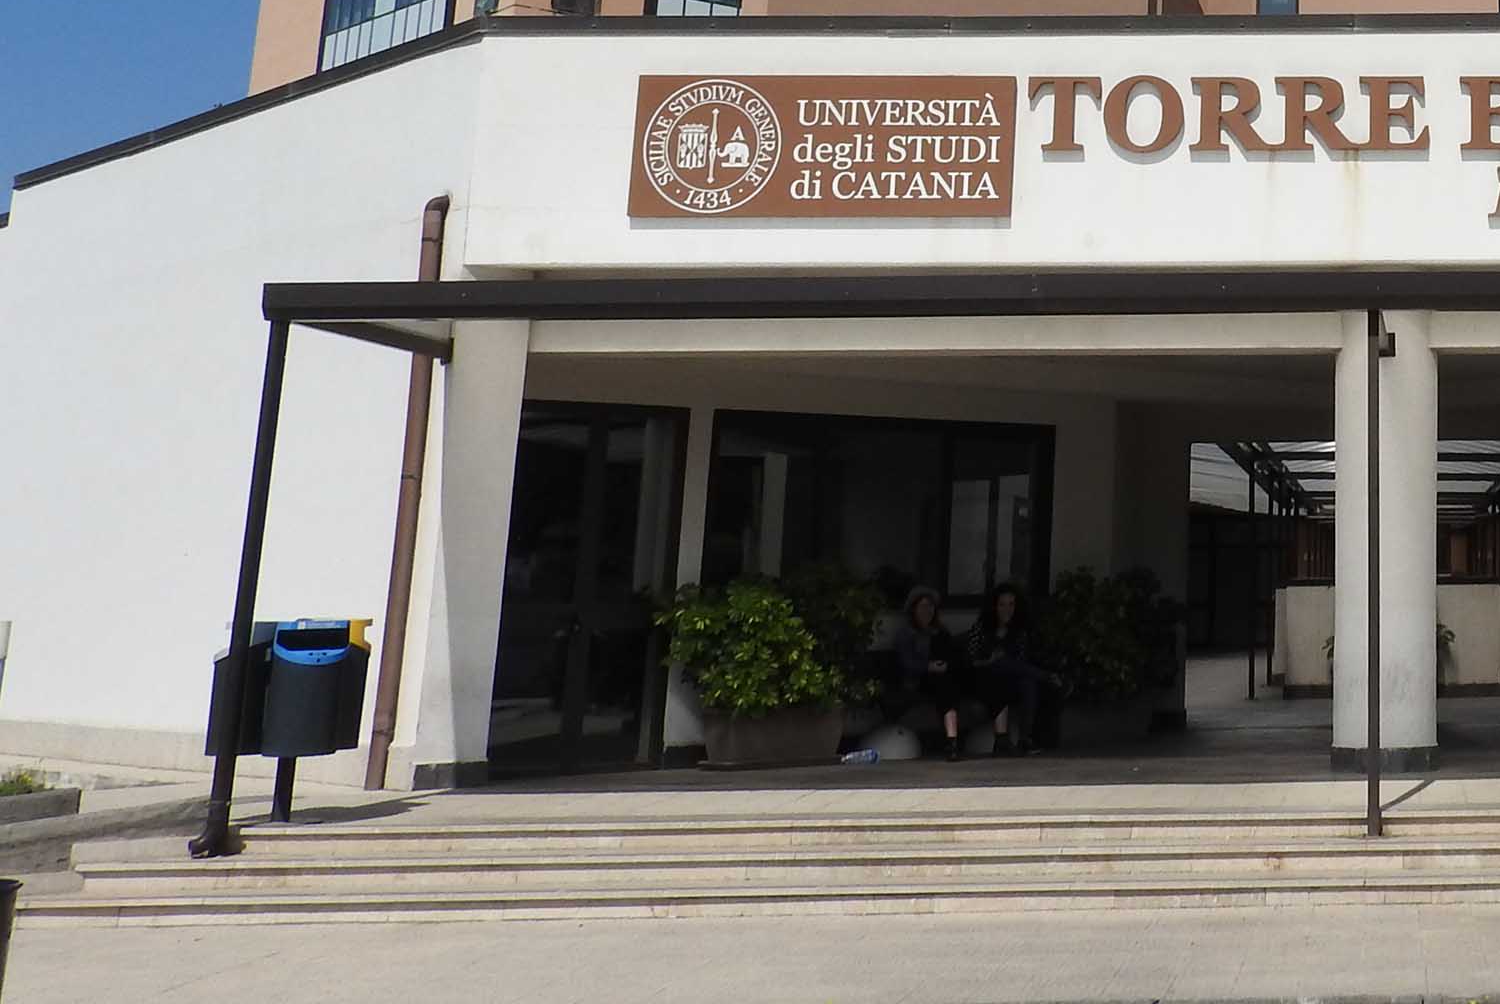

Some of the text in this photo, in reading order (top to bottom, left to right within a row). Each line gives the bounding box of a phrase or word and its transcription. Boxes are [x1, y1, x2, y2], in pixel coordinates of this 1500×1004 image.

[797, 92, 1001, 127] UNIVERSITÀ
[1028, 75, 1430, 156] TORRE
[649, 84, 777, 187] SICILIAE STVDIVM GENERALE
[792, 134, 1001, 171] degli STUDI
[683, 189, 732, 209] 1434
[789, 170, 1000, 200] di CATANIA
